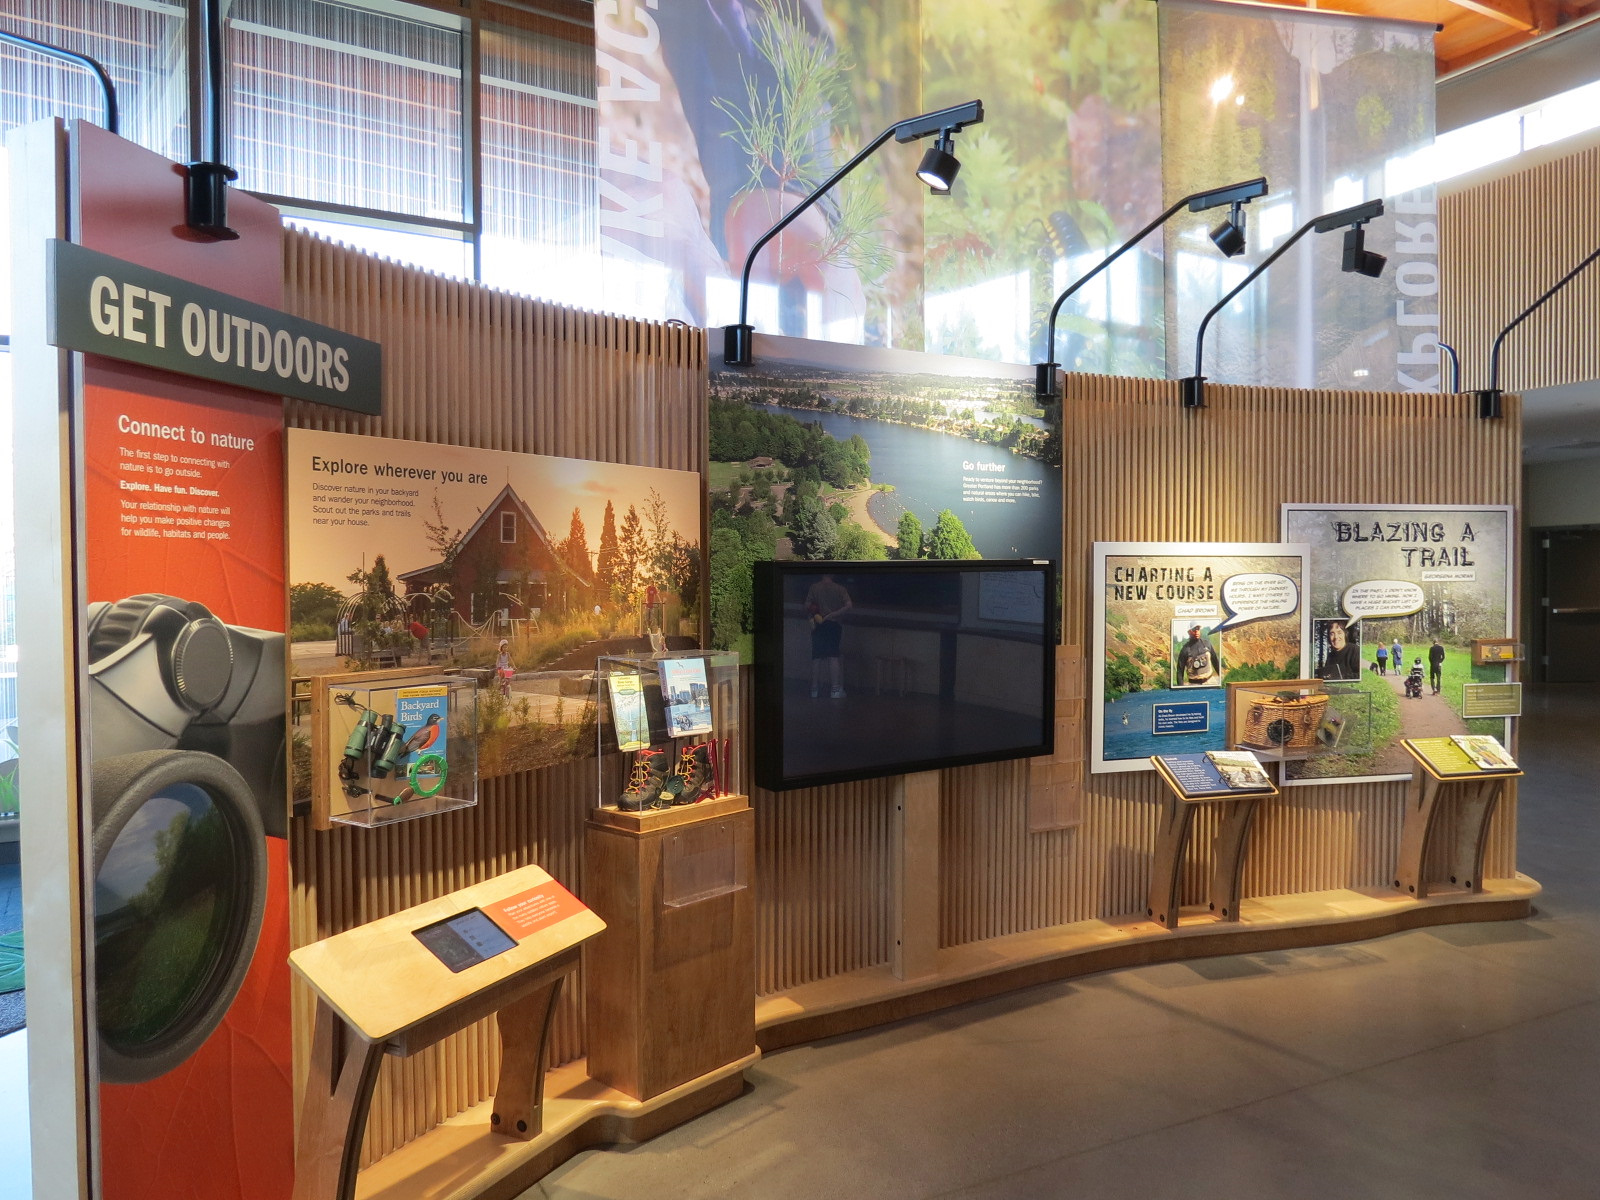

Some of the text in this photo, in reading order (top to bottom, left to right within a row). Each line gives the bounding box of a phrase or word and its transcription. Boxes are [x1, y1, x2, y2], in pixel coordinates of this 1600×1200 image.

[90, 275, 350, 392] GET OUTDOORS
[118, 414, 255, 451] Connect to nature
[119, 447, 230, 469] The first step to connecting with
[962, 460, 1006, 472] Go further
[120, 462, 202, 478] nature is to go outside.
[312, 456, 488, 484] Explore wherever you are
[120, 480, 220, 497] Explore. Have fun. Discover.
[312, 483, 343, 492] Discover
[344, 485, 366, 493] nature
[375, 488, 389, 496] your
[390, 488, 419, 498] backyard
[121, 500, 231, 515] Your relationship with nature will
[312, 505, 412, 518] Scout out the parks and trails
[121, 514, 230, 529] help you make positive changes
[347, 518, 369, 526] house.
[121, 527, 230, 540] for wildlife, habitats and people.
[1333, 521, 1475, 542] BLAZING A
[1401, 546, 1475, 567] TRAIL
[1114, 566, 1213, 582] CHARTING A
[1114, 584, 1214, 601] NEW COURSE
[401, 699, 439, 711] Backyard
[401, 711, 423, 722] Birds
